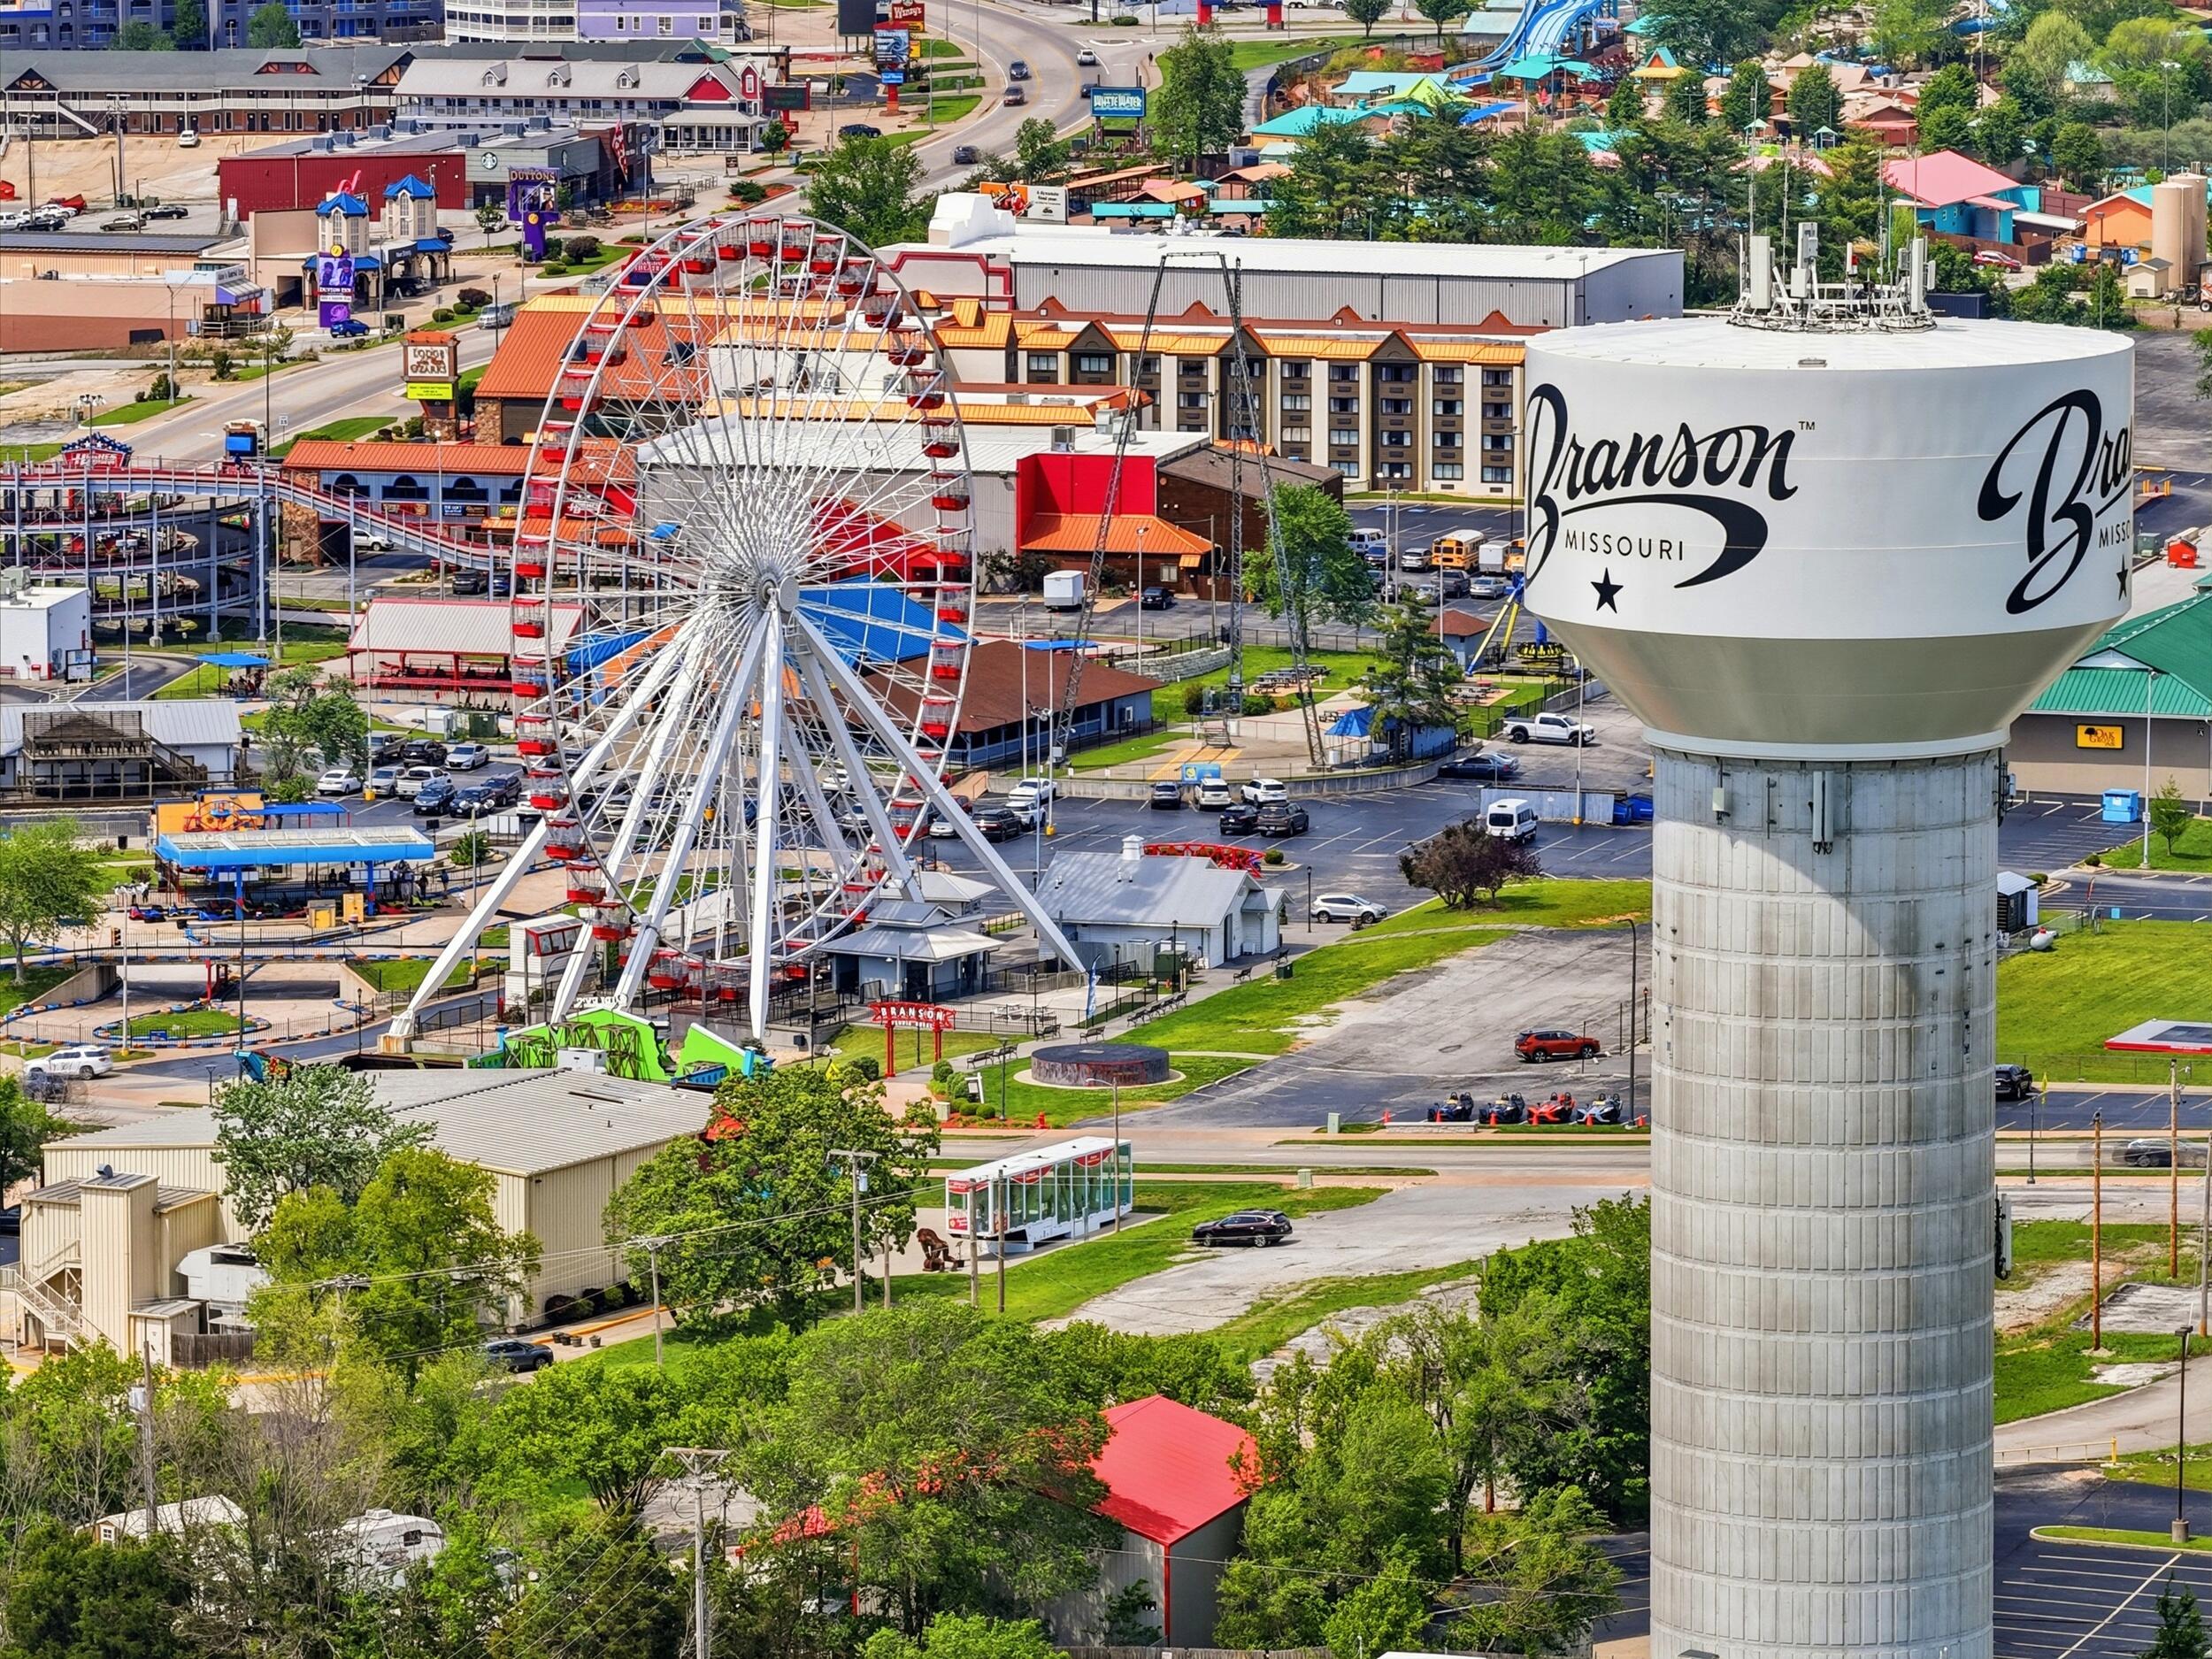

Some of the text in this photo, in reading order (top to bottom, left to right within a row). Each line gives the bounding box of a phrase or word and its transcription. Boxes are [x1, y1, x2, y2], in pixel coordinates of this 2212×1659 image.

[1525, 383, 1798, 589] Branson
[1564, 529, 1684, 561] MISSOURI
[880, 1007, 942, 1020] BRANSON
